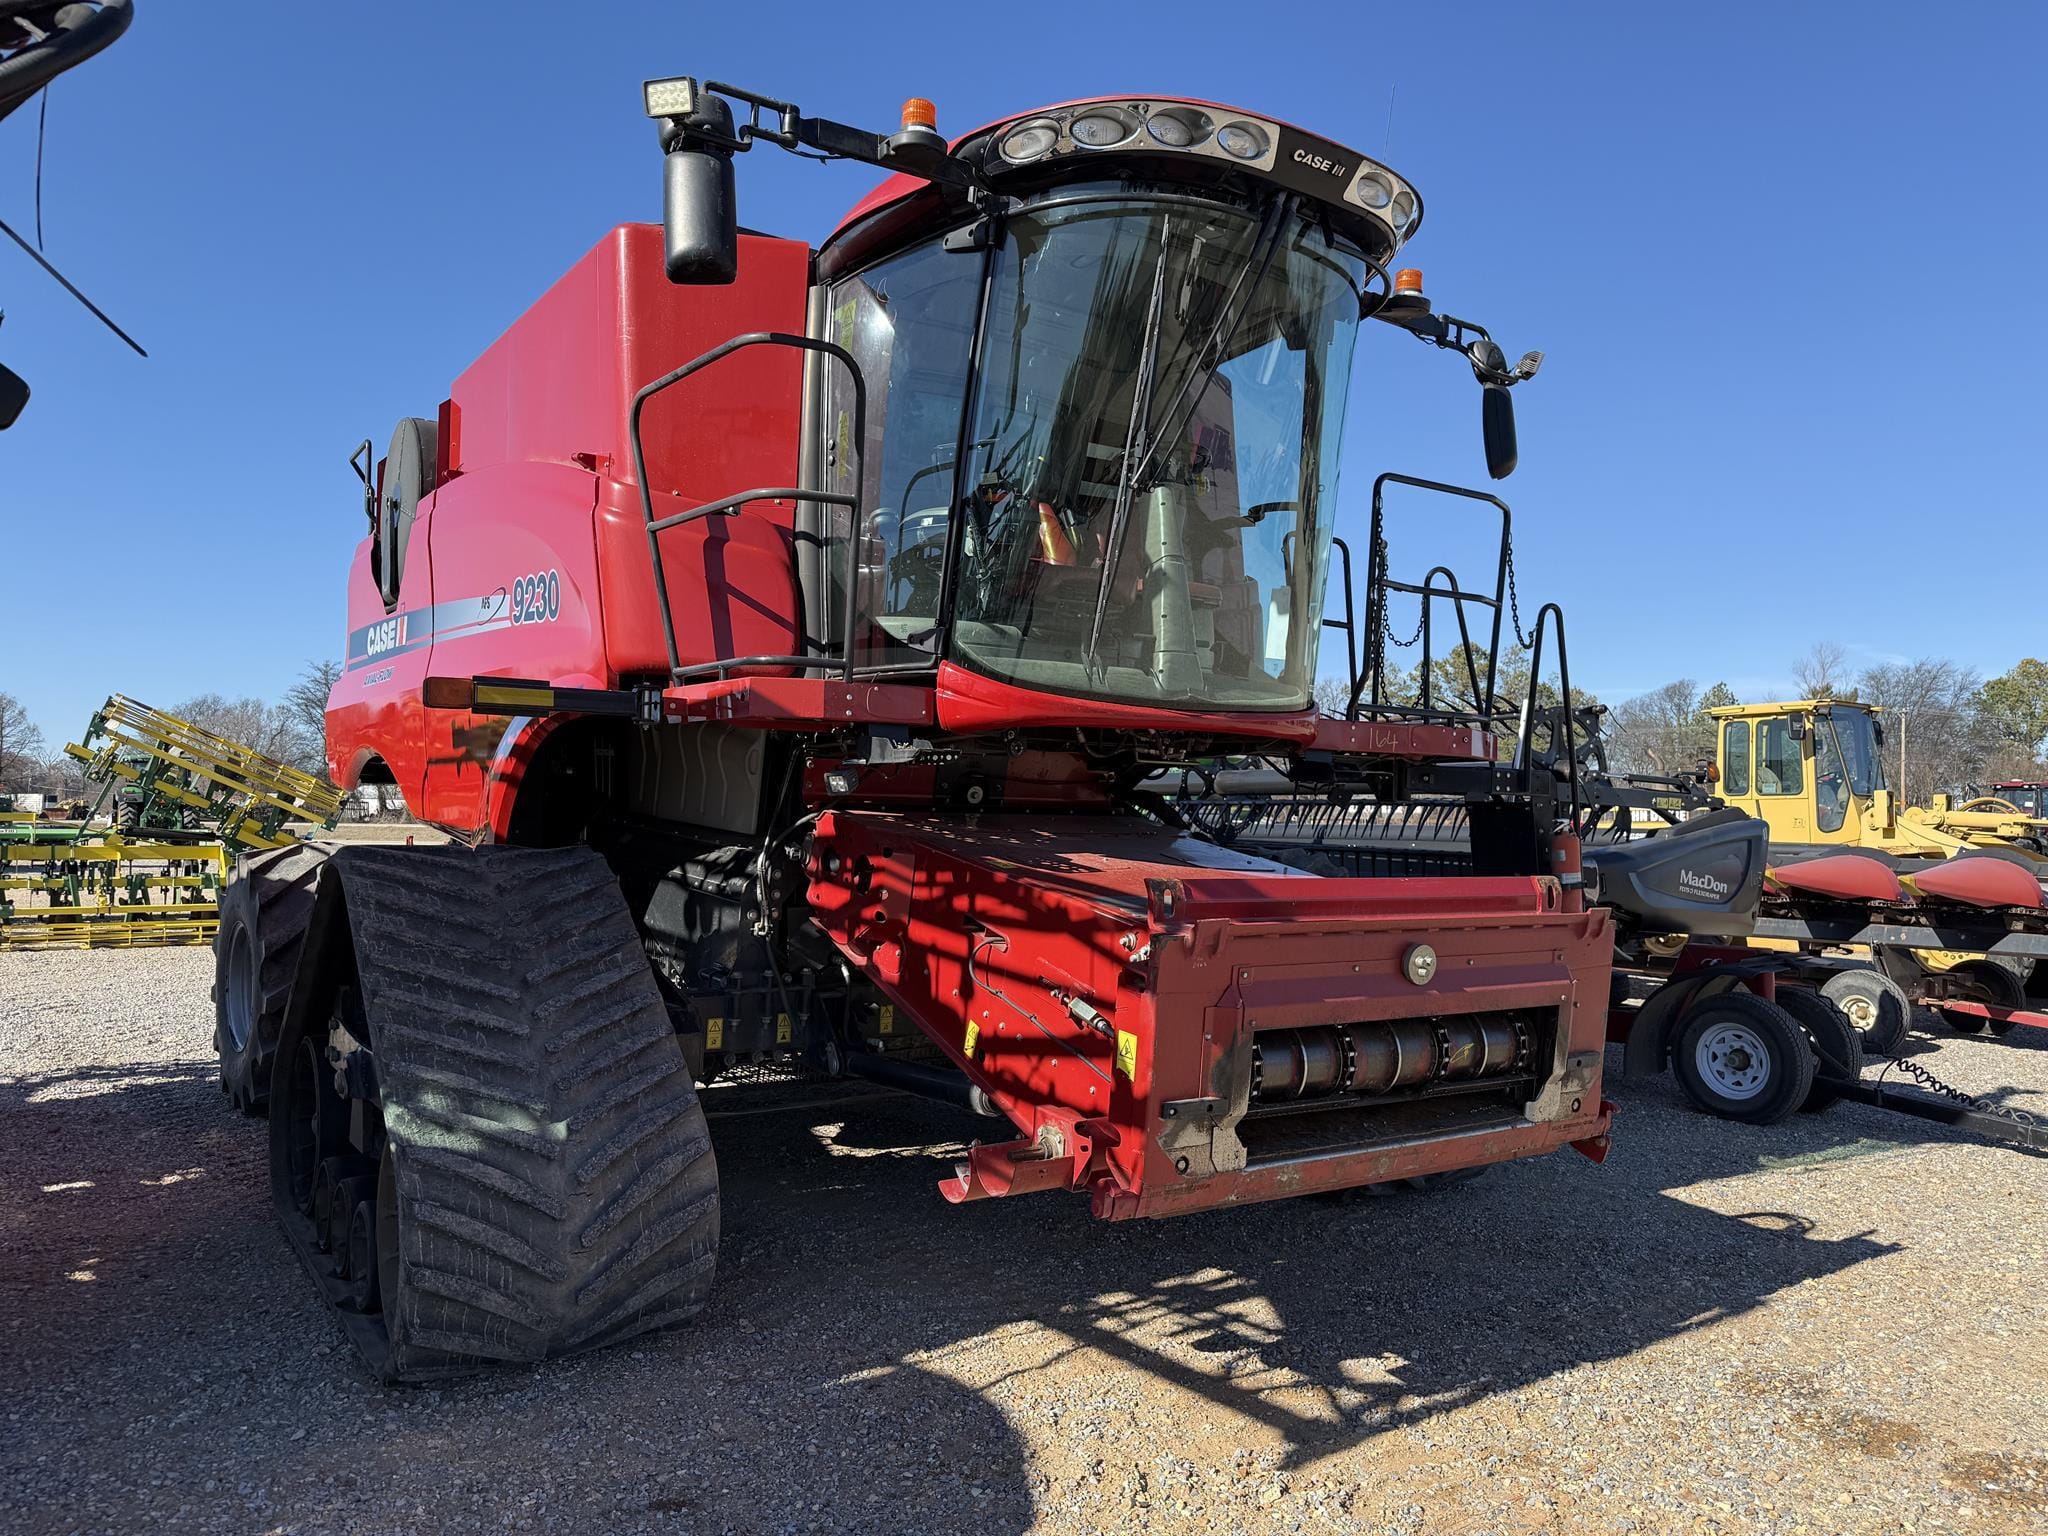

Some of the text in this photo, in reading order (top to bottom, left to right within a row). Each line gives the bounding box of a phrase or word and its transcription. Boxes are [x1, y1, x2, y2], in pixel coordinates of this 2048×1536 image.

[1293, 149, 1332, 172] CASE
[512, 568, 561, 626] 9230
[367, 619, 396, 656] CASE
[1680, 868, 1728, 894] MacDon
